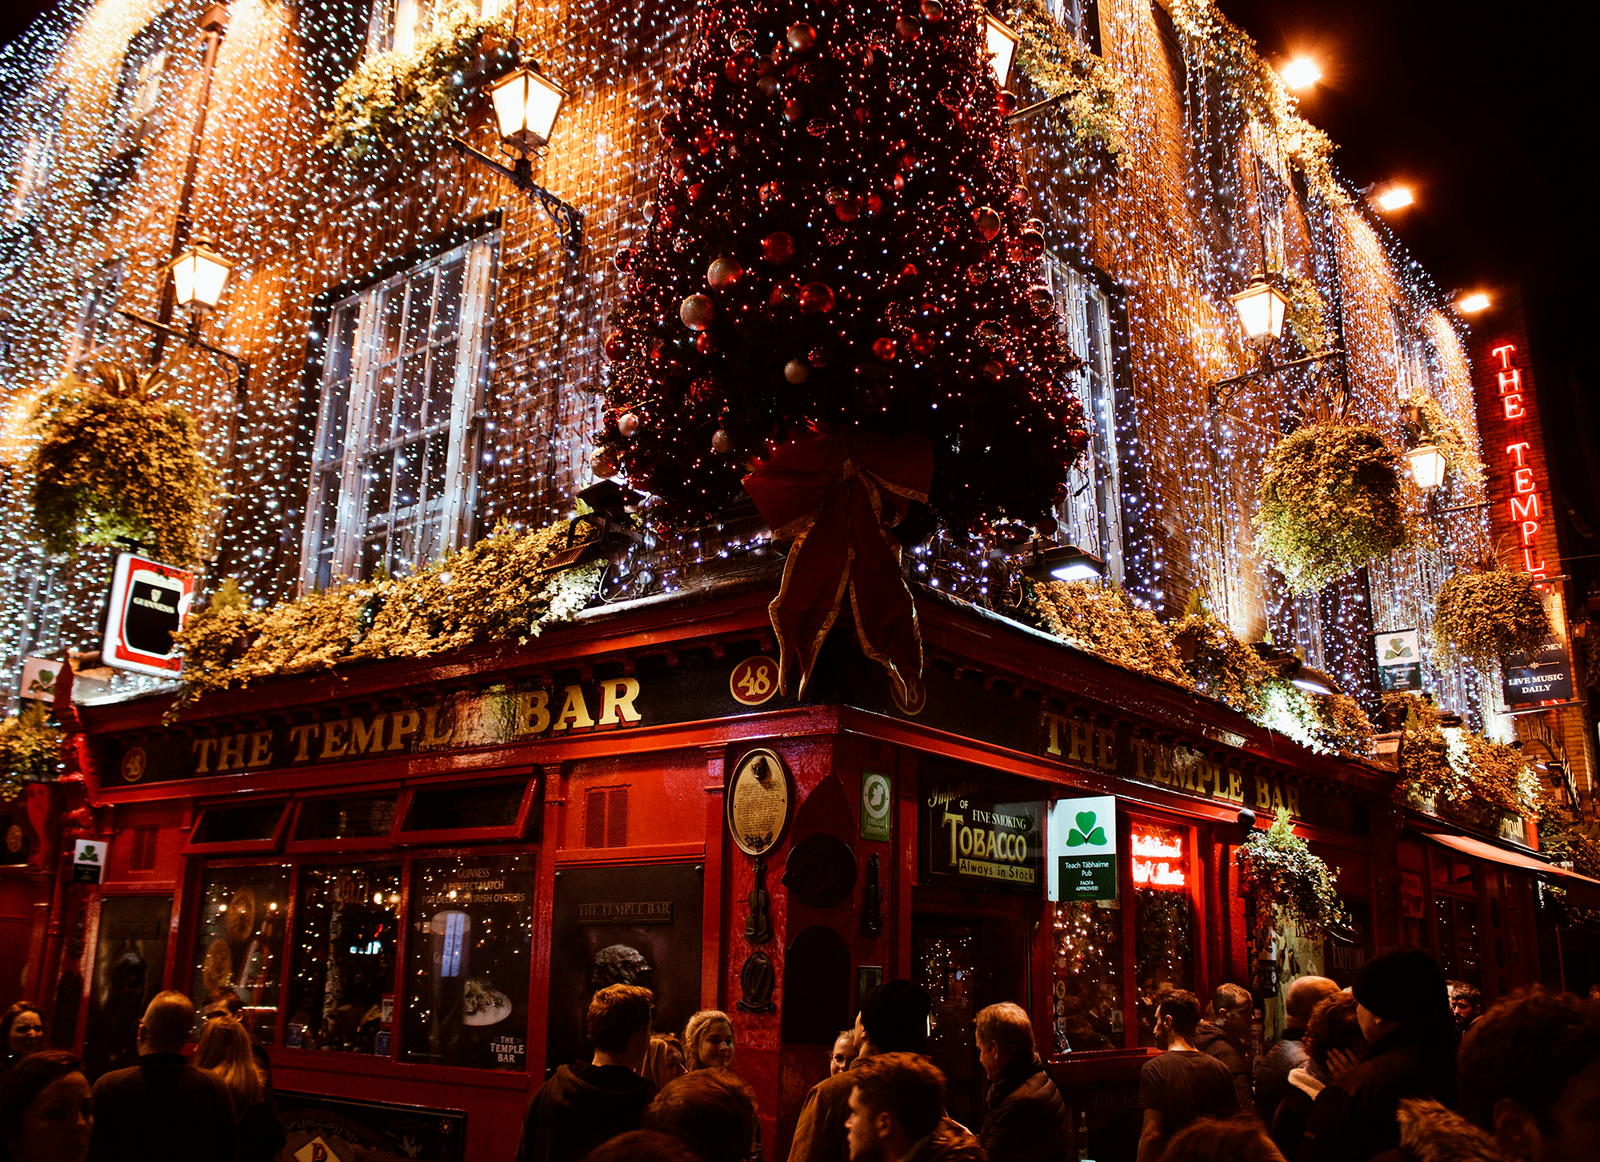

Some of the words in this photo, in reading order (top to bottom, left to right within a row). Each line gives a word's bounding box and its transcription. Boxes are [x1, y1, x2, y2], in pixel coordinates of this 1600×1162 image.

[1492, 345, 1526, 421] THE
[737, 665, 771, 697] 48
[1508, 676, 1531, 687] LIVE
[1531, 673, 1564, 684] MUSIC
[1521, 684, 1552, 694] DAILY
[192, 730, 274, 774] THE
[289, 704, 456, 762] TEMPL
[515, 676, 642, 736] BAR
[1041, 710, 1118, 772] THE
[1129, 735, 1246, 804] TEMPLE
[1253, 775, 1302, 818] BAR
[927, 781, 978, 811] Importers
[959, 799, 969, 810] OF
[972, 809, 991, 824] FINE
[992, 812, 1027, 830] SMOKING
[941, 811, 1028, 866] TOBACCO
[960, 859, 993, 876] Always
[997, 867, 1006, 877] in
[1008, 866, 1034, 881] Stock
[1065, 861, 1081, 869] Teach
[457, 867, 490, 879] GUINNESS
[442, 883, 448, 891] A
[448, 881, 478, 891] PERFECT
[478, 881, 504, 890] MATCH
[421, 895, 435, 904] FOR
[473, 893, 493, 903] IRISH
[493, 892, 526, 903] OYSTERS
[580, 904, 598, 916] THE
[602, 903, 644, 916] TEMPLE
[647, 902, 671, 915] BAR
[500, 1036, 515, 1044] THE
[490, 1042, 525, 1055] TEMPLE
[497, 1053, 516, 1063] BAR
